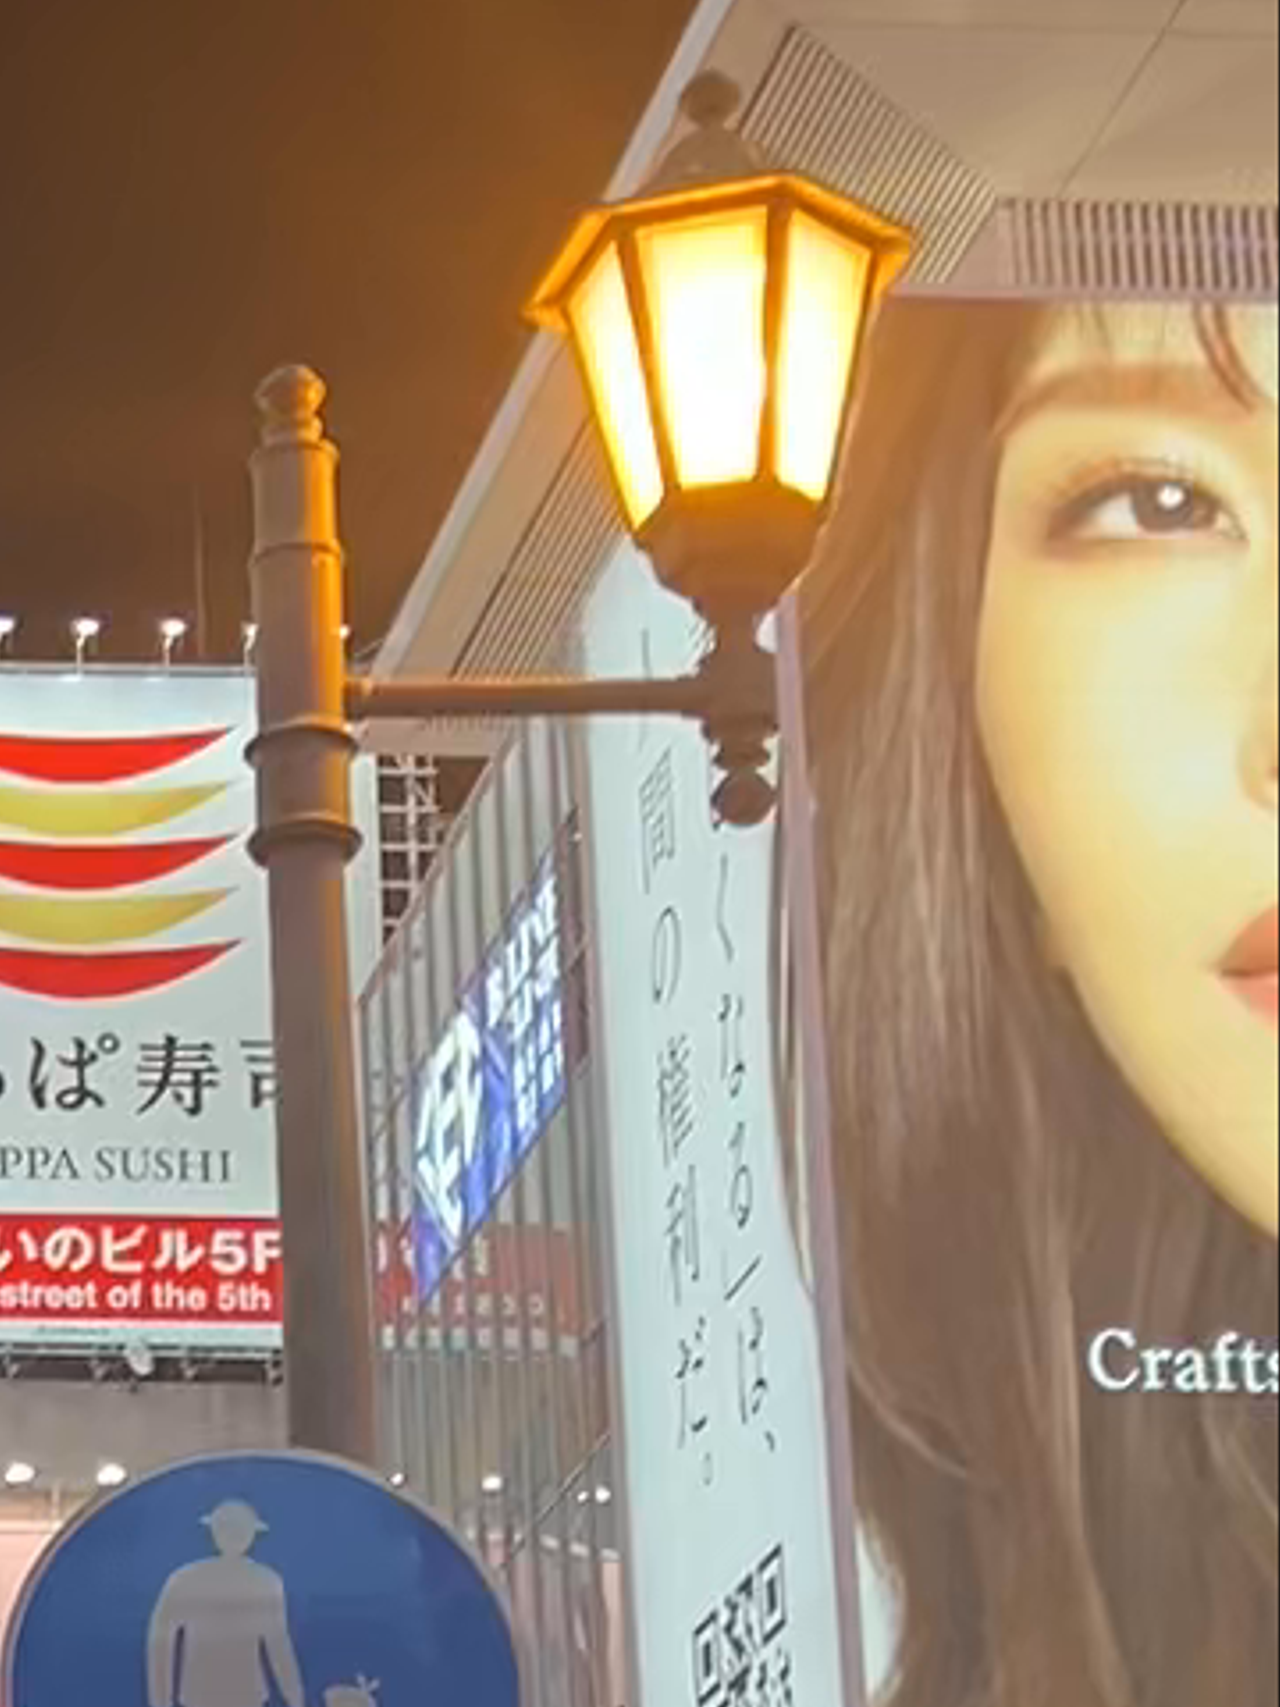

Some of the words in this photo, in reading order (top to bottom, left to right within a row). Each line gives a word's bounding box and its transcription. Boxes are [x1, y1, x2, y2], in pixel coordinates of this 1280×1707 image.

[94, 1145, 233, 1185] SUSHI
[106, 1278, 141, 1311] of
[149, 1279, 210, 1311] the
[215, 1281, 273, 1313] 5th
